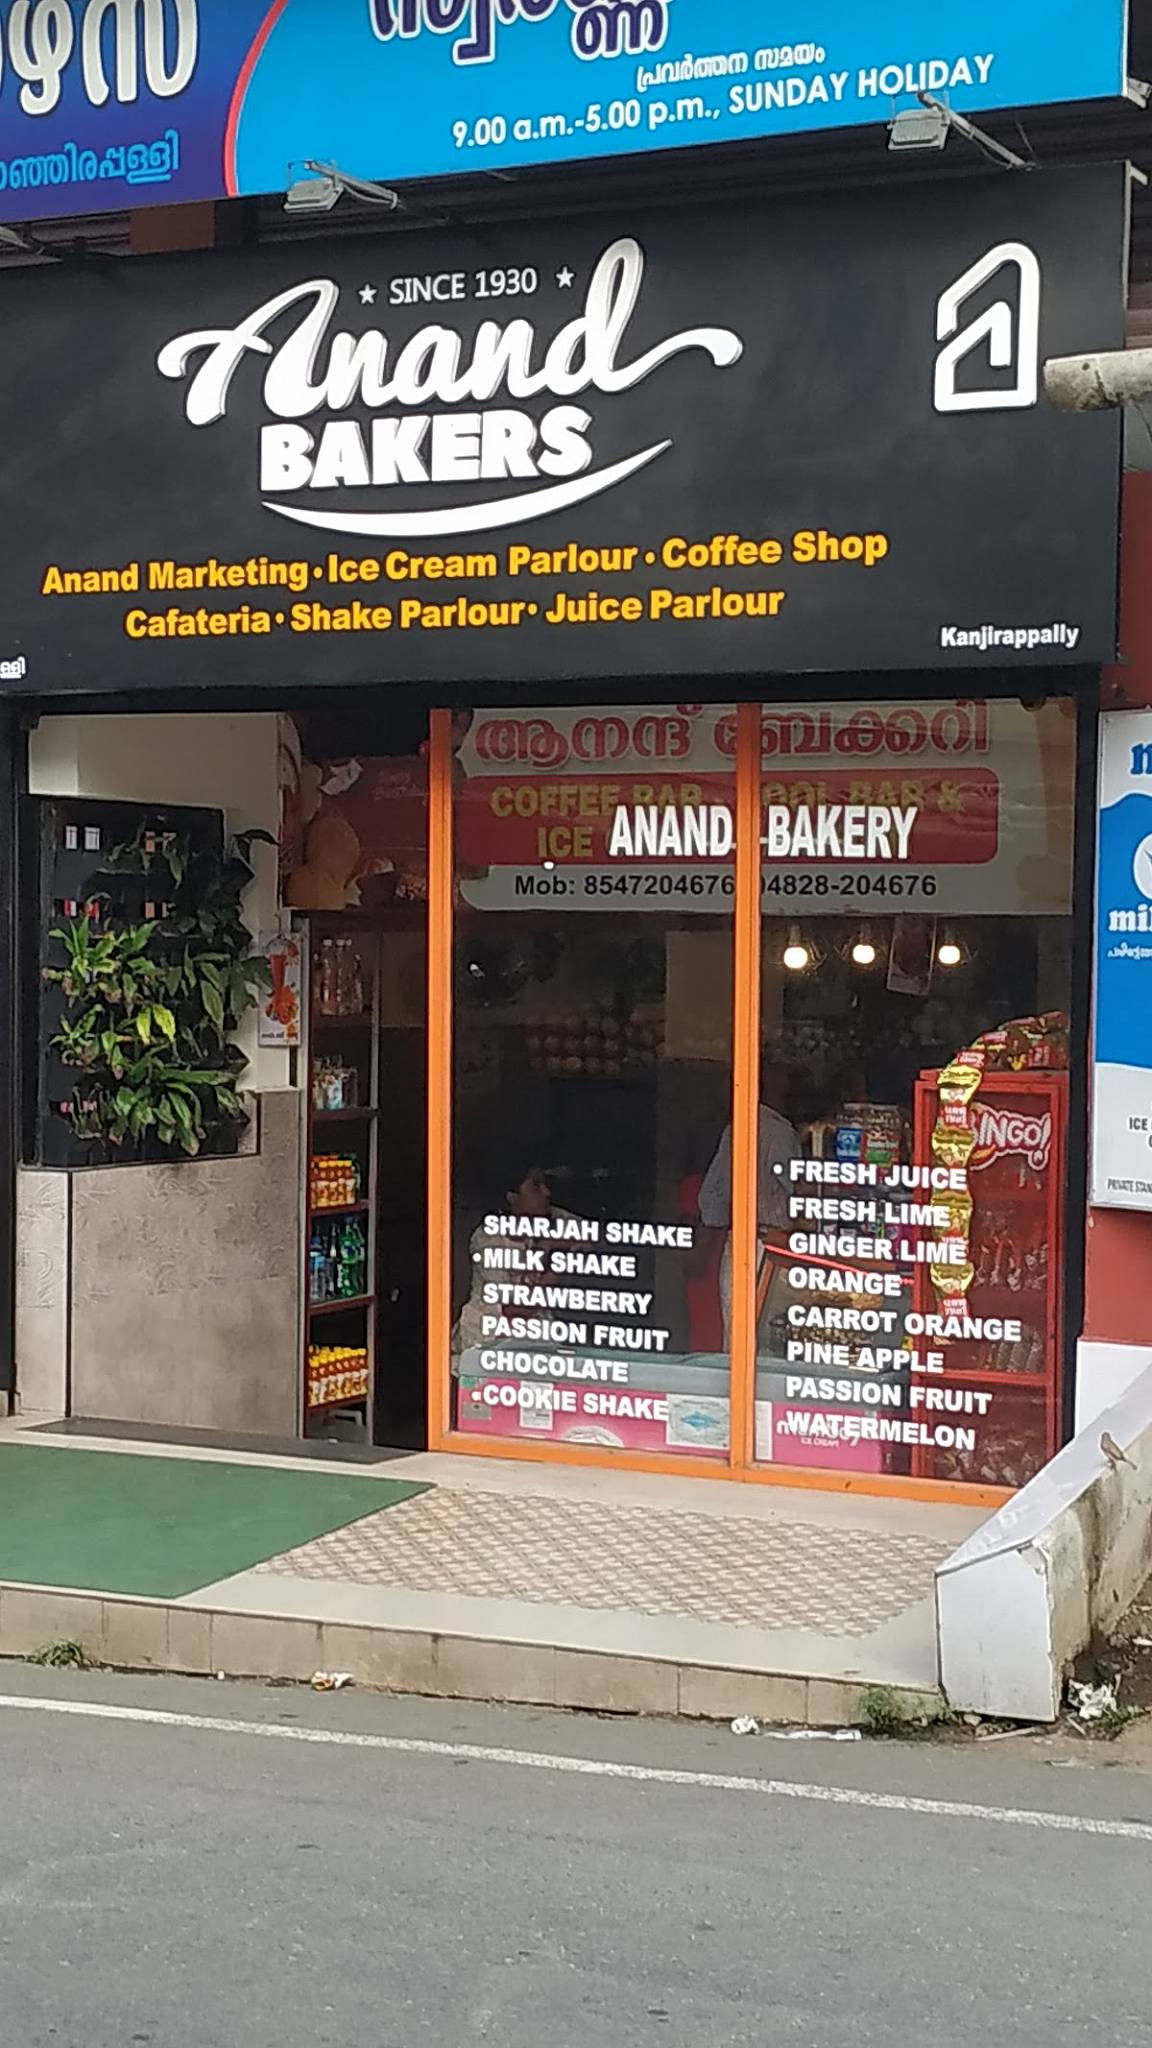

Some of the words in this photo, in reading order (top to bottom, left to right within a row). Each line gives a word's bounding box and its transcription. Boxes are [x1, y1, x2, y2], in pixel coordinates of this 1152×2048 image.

[754, 42, 826, 71] സമയം
[452, 116, 507, 148] 9.00
[649, 95, 720, 131] p.m.,
[729, 71, 848, 114] SUNDAY
[858, 53, 994, 98] HOLIDAY
[389, 273, 465, 305] SINCE
[474, 266, 538, 298] 1930
[157, 238, 743, 426] Anand
[260, 404, 594, 491] BAKERS
[42, 563, 139, 595] Anand
[148, 557, 309, 592] Marketing
[328, 553, 380, 583] Ice
[385, 548, 497, 580] Cream
[508, 543, 639, 576] Parlour
[662, 535, 782, 569] Coffee
[792, 530, 889, 567] Shop
[125, 605, 271, 639] Cafateria
[290, 601, 392, 633] Shake
[400, 597, 527, 629] Parlour
[545, 592, 642, 624] Juice
[649, 587, 785, 620] Parlour
[941, 623, 1080, 650] Kanjirappally
[490, 784, 618, 817] COFFEE
[536, 827, 593, 858] ICE
[515, 875, 576, 895] Mob:
[584, 875, 735, 896] 8547204676
[1109, 903, 1152, 931] mi
[972, 1111, 1050, 1161] INGO!
[1129, 1116, 1148, 1131] ICE
[790, 1160, 877, 1186] FRESH
[885, 1165, 967, 1190] JUICE
[789, 1197, 876, 1222] FRESH
[884, 1203, 951, 1227] LIME
[484, 1215, 599, 1241] SHARJAH
[606, 1222, 693, 1248] SHAKE
[789, 1232, 893, 1260] GINGER
[900, 1240, 967, 1264] LIME
[483, 1248, 544, 1272] MILK
[551, 1252, 636, 1277] SHAKE
[788, 1267, 901, 1297] ORANGE
[483, 1283, 652, 1315] STRAWBERRY
[482, 1316, 586, 1344] PASSION
[594, 1325, 669, 1351] FRUIT
[787, 1305, 897, 1333] CARROT
[904, 1315, 1022, 1342] ORANGE
[480, 1351, 629, 1382] CHOCOLATE
[787, 1340, 849, 1366] PINE
[856, 1347, 944, 1374] APPLE
[483, 1384, 577, 1412] COOKIE
[583, 1393, 669, 1422] SHAKE
[786, 1375, 901, 1406] PASSION
[910, 1386, 992, 1415] FRUIT
[786, 1410, 975, 1451] WATERMELON
